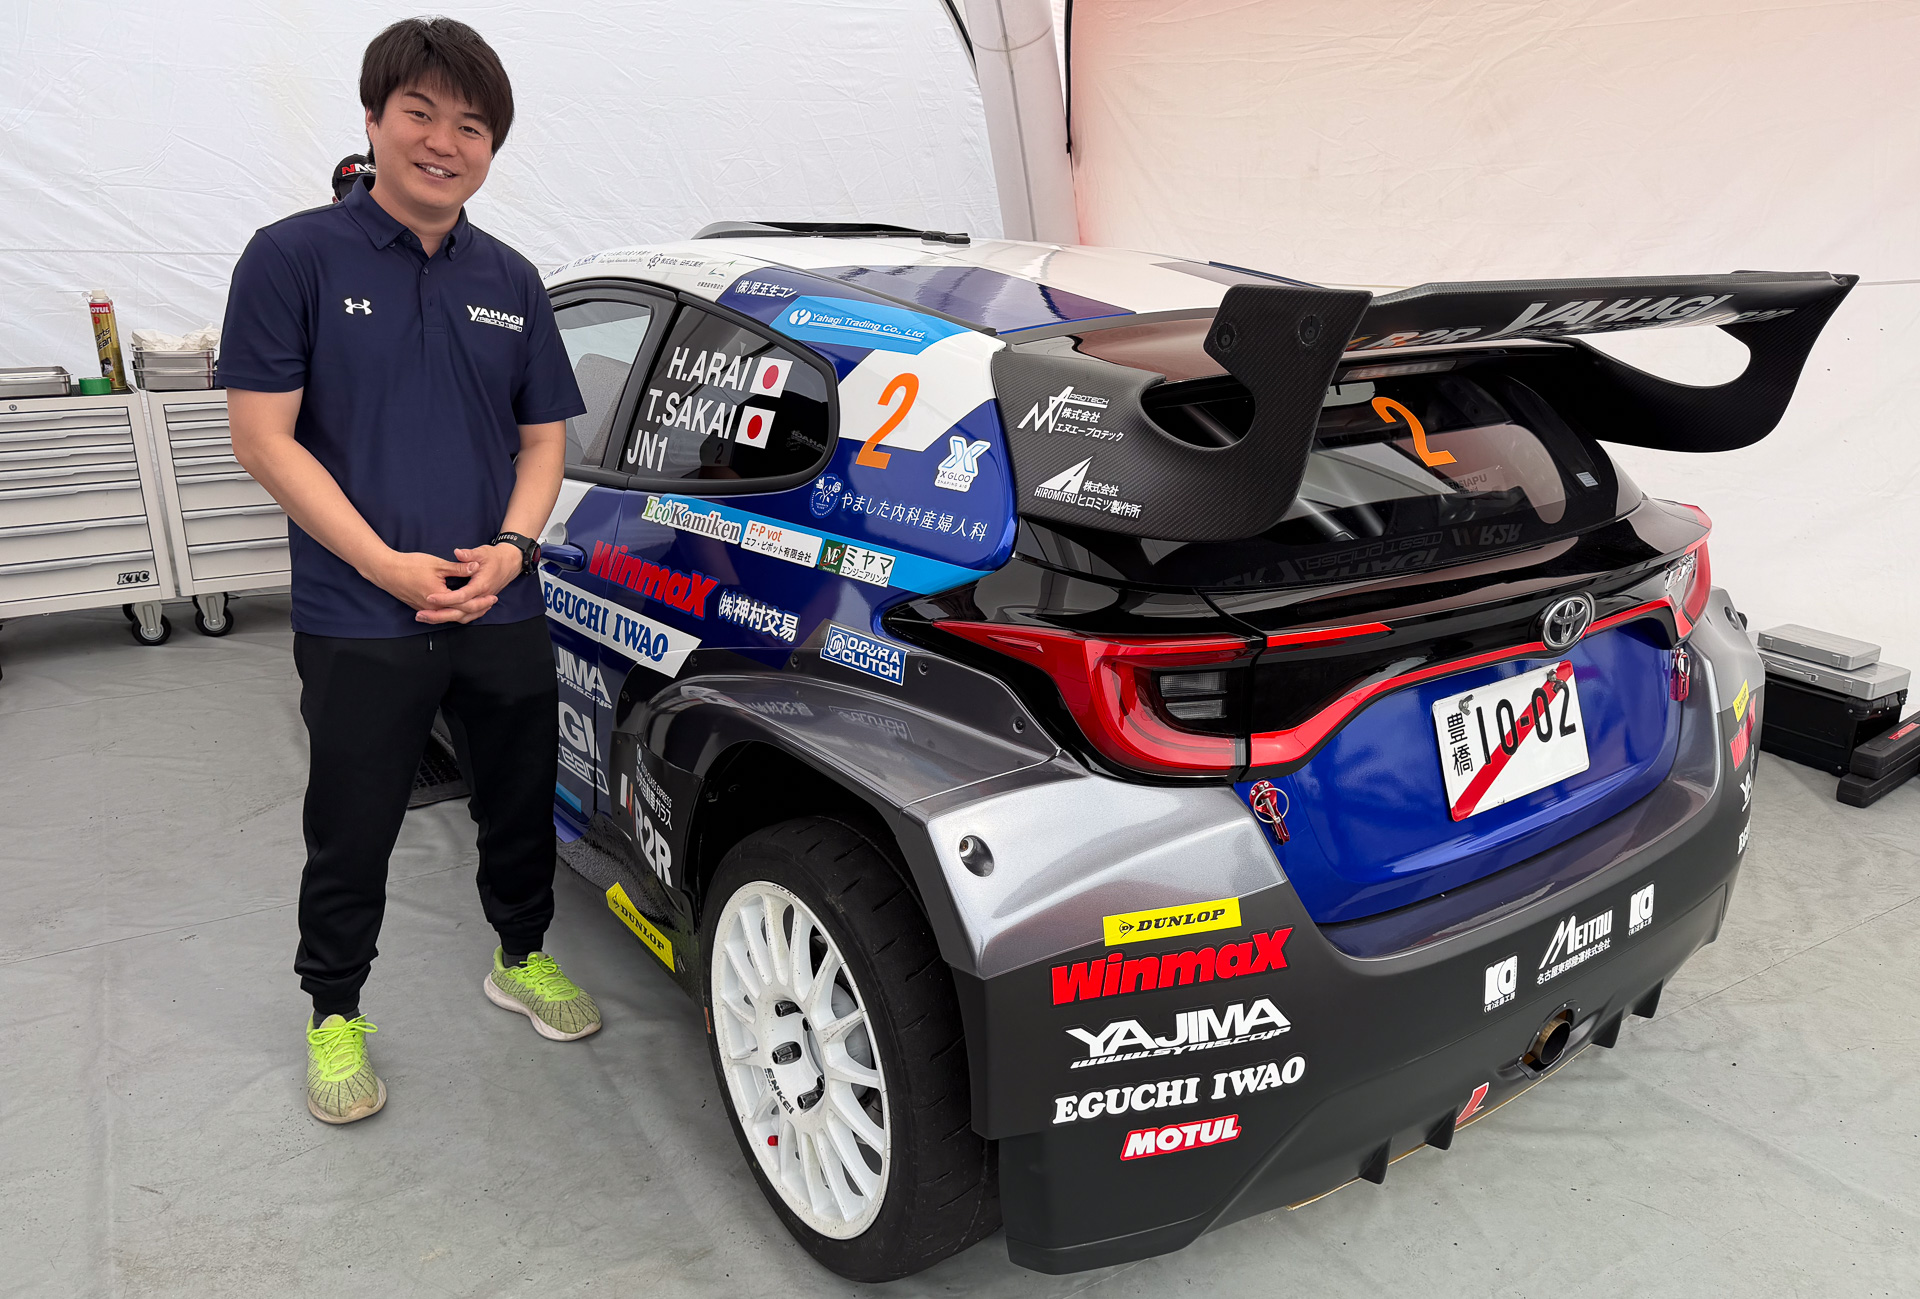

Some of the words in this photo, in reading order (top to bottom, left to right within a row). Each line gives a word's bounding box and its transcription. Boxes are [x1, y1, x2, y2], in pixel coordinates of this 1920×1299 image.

[466, 305, 524, 326] YAHAGI
[812, 312, 843, 326] Yahagi
[845, 317, 882, 333] Trading
[882, 324, 902, 336] Co.,
[904, 328, 925, 339] Ltd.
[667, 346, 753, 391] H.ARAI
[646, 388, 738, 440] T.SAKAI
[855, 372, 920, 471] 2
[1055, 423, 1124, 442] エヌエープロテック
[1061, 407, 1101, 424] 株式会社
[1371, 396, 1457, 468] 2
[626, 430, 669, 472] JN1
[939, 470, 947, 478] X
[947, 471, 971, 483] GLOO
[1083, 480, 1120, 497] 株式会社
[841, 492, 988, 542] やました内科産婦人科
[1034, 487, 1078, 504] HIROMITSU
[1077, 494, 1142, 519] ヒロミツ製作所
[767, 529, 783, 543] vot
[117, 570, 149, 585] KTC
[841, 565, 889, 585] エンジニアリング
[845, 547, 893, 575] ミヤマ
[543, 580, 607, 636] EGUCHI
[615, 613, 669, 663] IWAO
[719, 590, 799, 642] (株)神村交易
[842, 650, 900, 680] CLUTCH
[847, 637, 900, 665] OGURA
[1476, 680, 1577, 765] 10-02
[1447, 712, 1474, 777] 豊橋
[620, 905, 665, 950] DUNLOP
[1137, 908, 1225, 932] DUNLOP
[1065, 998, 1291, 1058] YAJIMA
[767, 1068, 795, 1114] ENKEI
[1053, 1077, 1200, 1124] EGUCHI
[1211, 1056, 1305, 1100] IWAO
[1123, 1117, 1240, 1158] MOTUL
